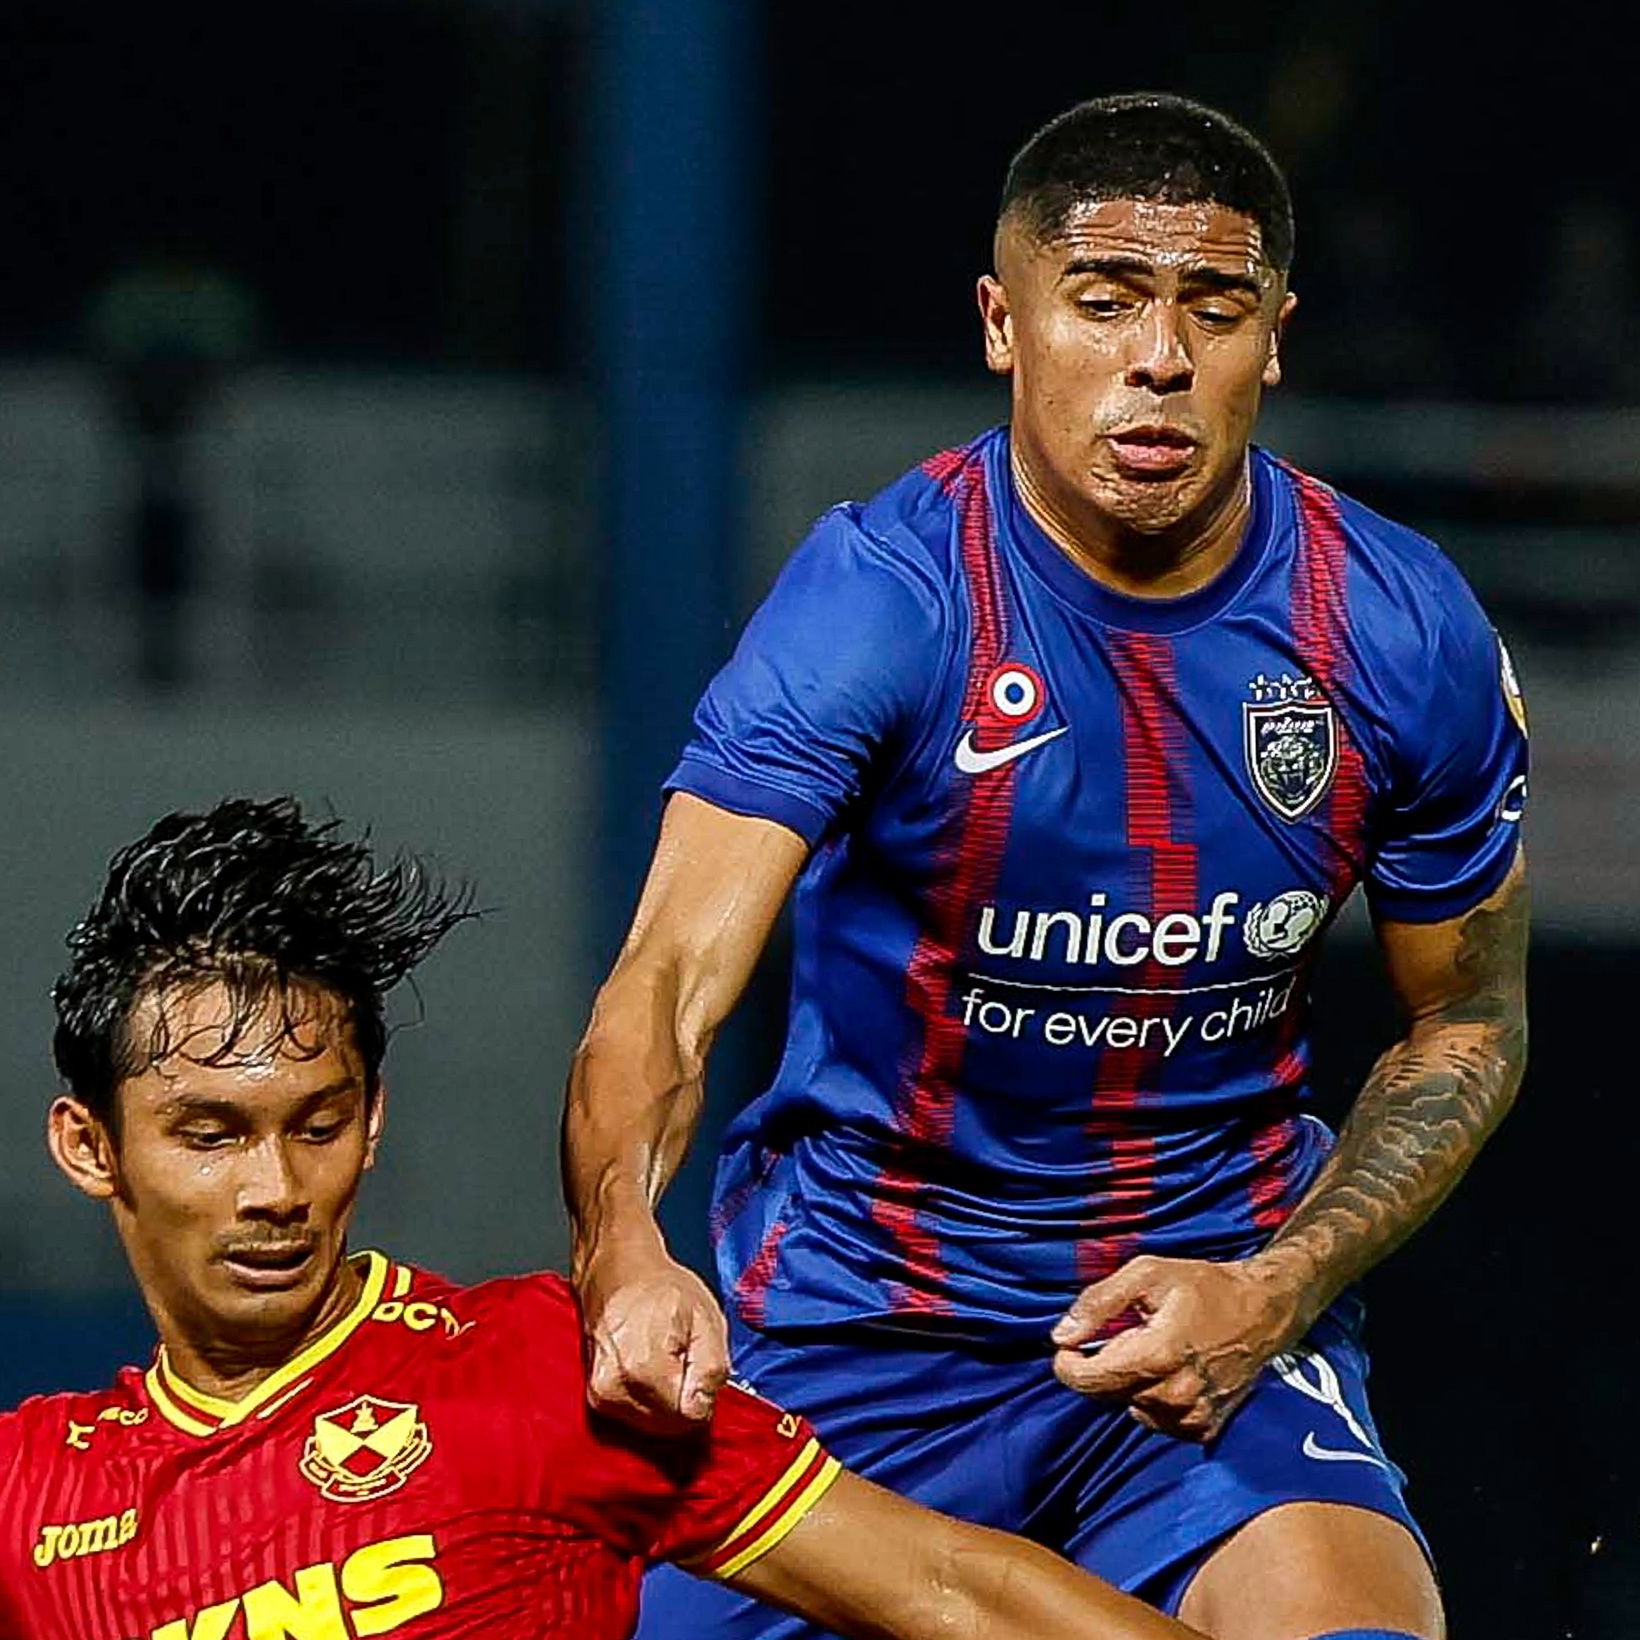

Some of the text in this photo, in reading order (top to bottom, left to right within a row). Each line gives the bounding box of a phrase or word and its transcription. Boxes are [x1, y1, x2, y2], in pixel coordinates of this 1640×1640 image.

[976, 891, 1239, 967] unicef
[961, 974, 1298, 1058] for every child
[33, 1508, 139, 1567] Joma
